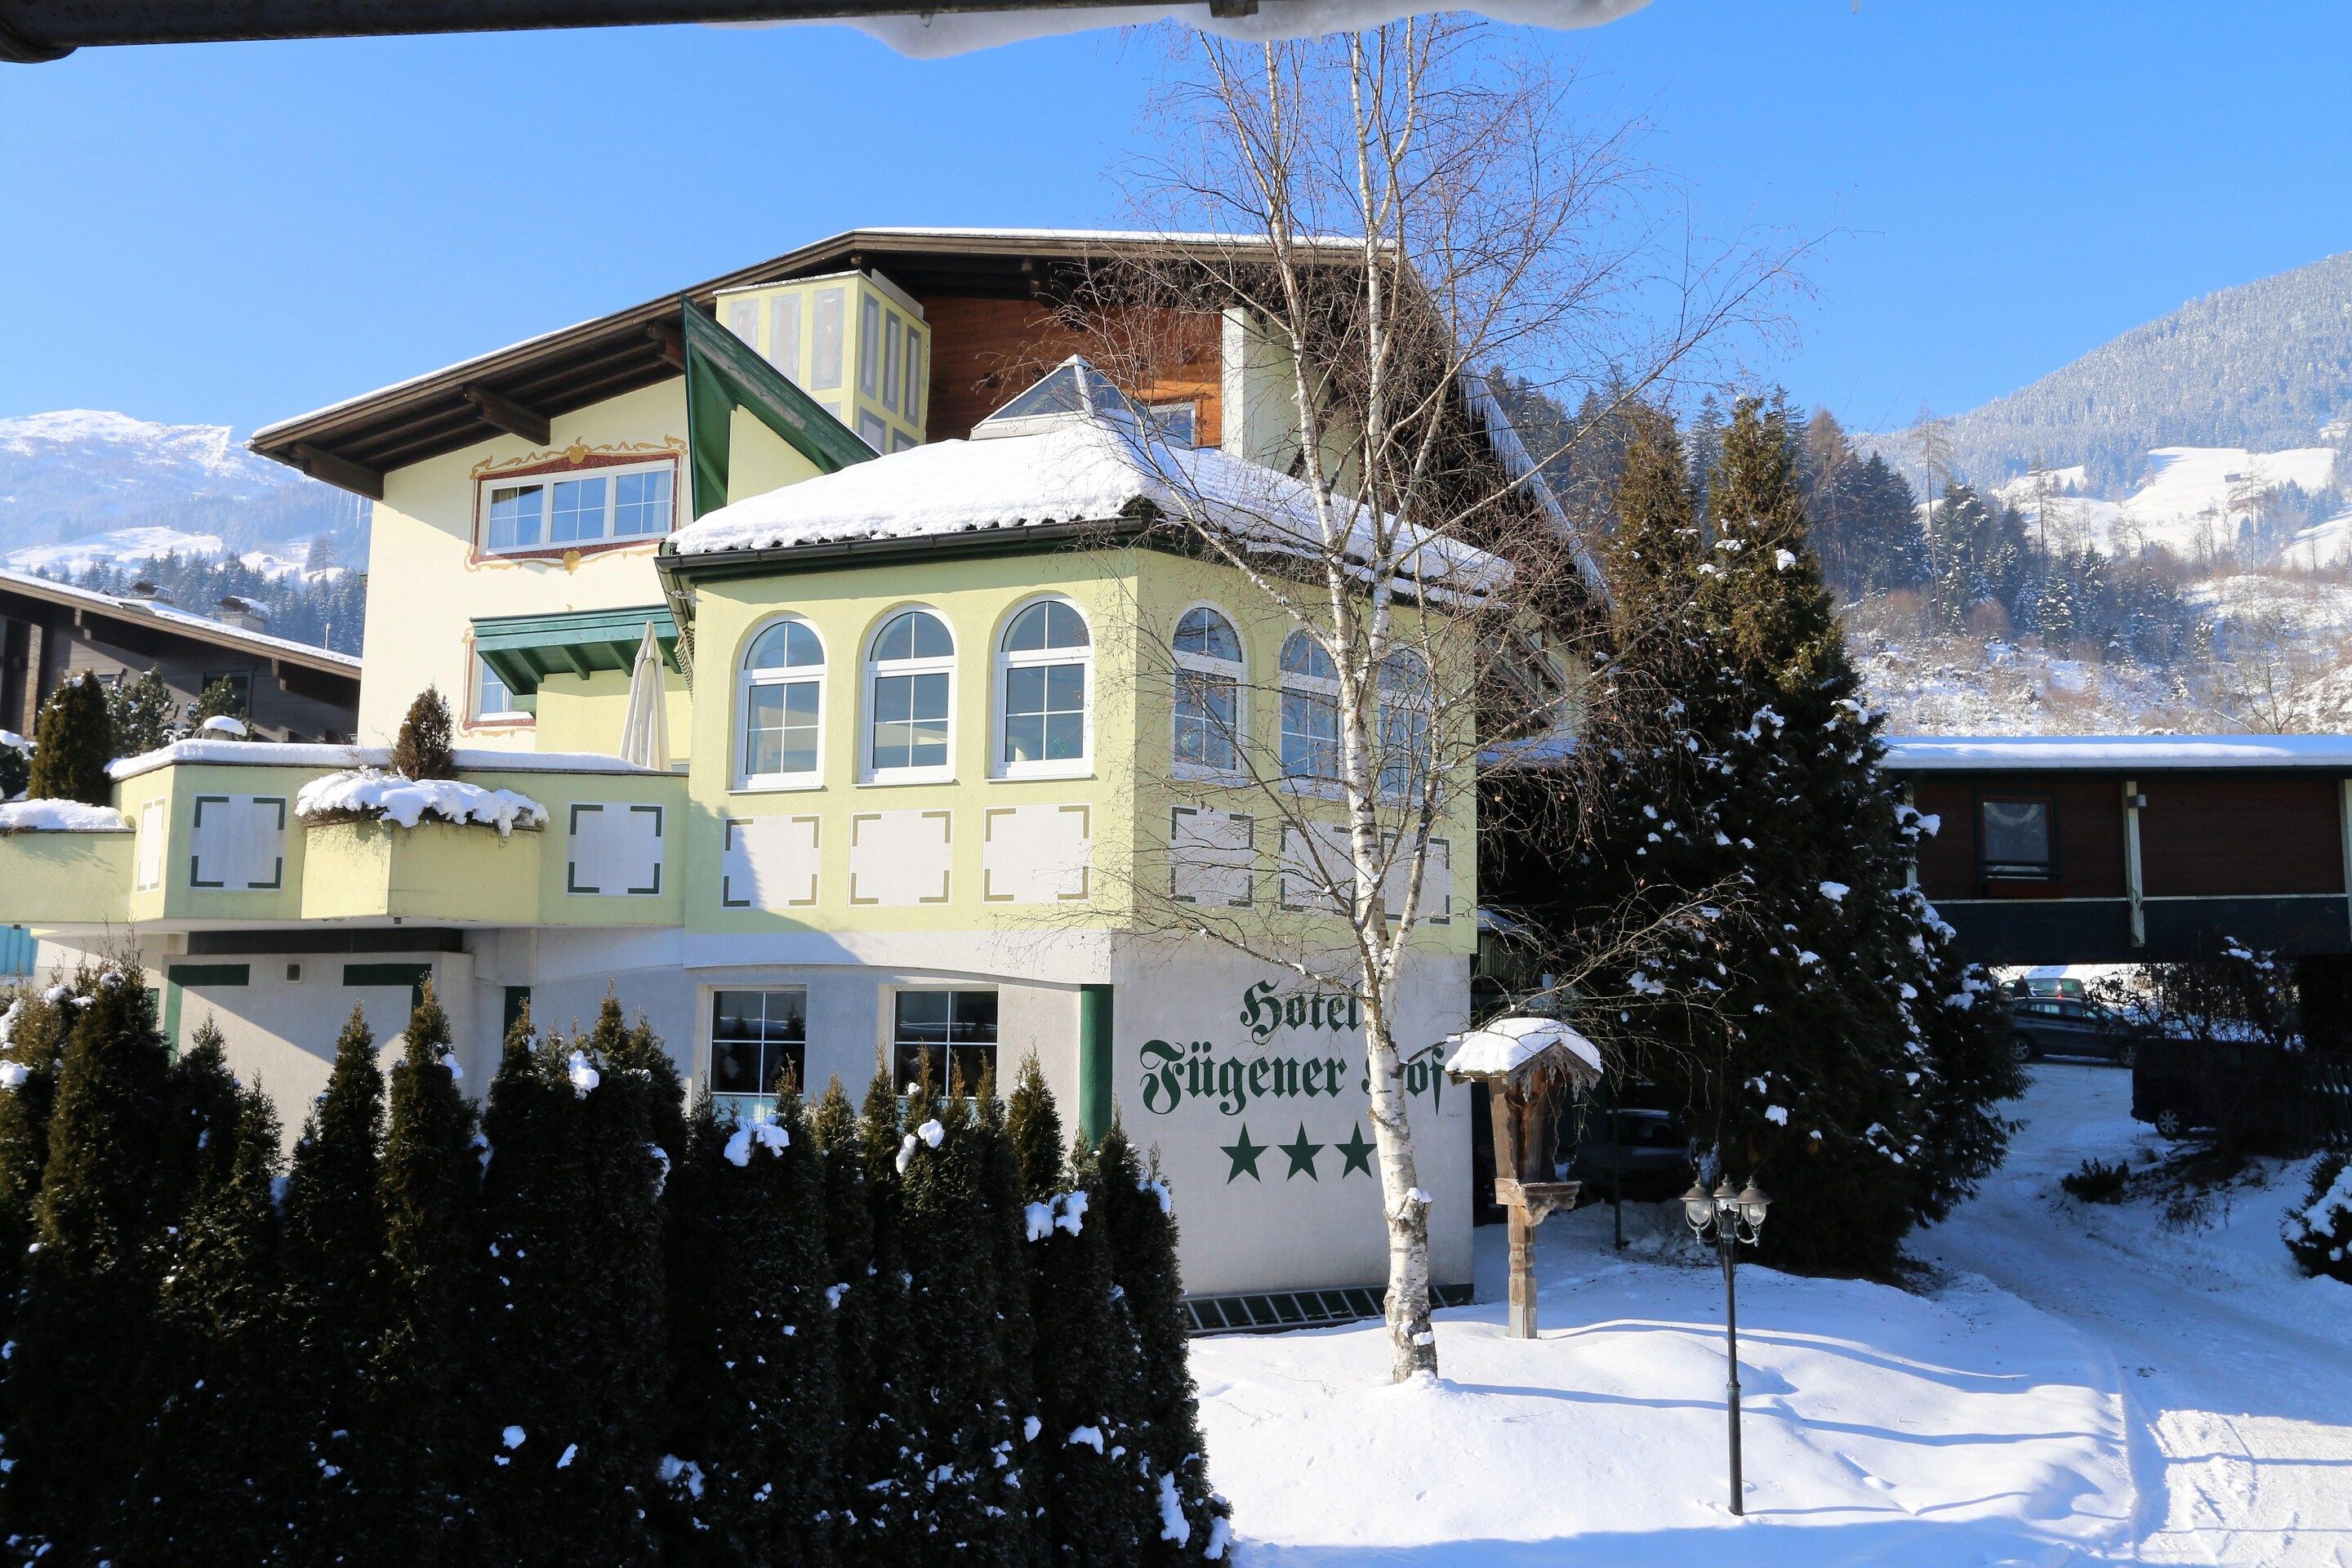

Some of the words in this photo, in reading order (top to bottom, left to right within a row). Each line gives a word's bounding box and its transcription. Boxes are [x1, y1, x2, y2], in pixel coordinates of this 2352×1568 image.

[1240, 980, 1362, 1045] Hotel
[1139, 1039, 1348, 1116] Fügener
[1361, 1045, 1446, 1116] of
